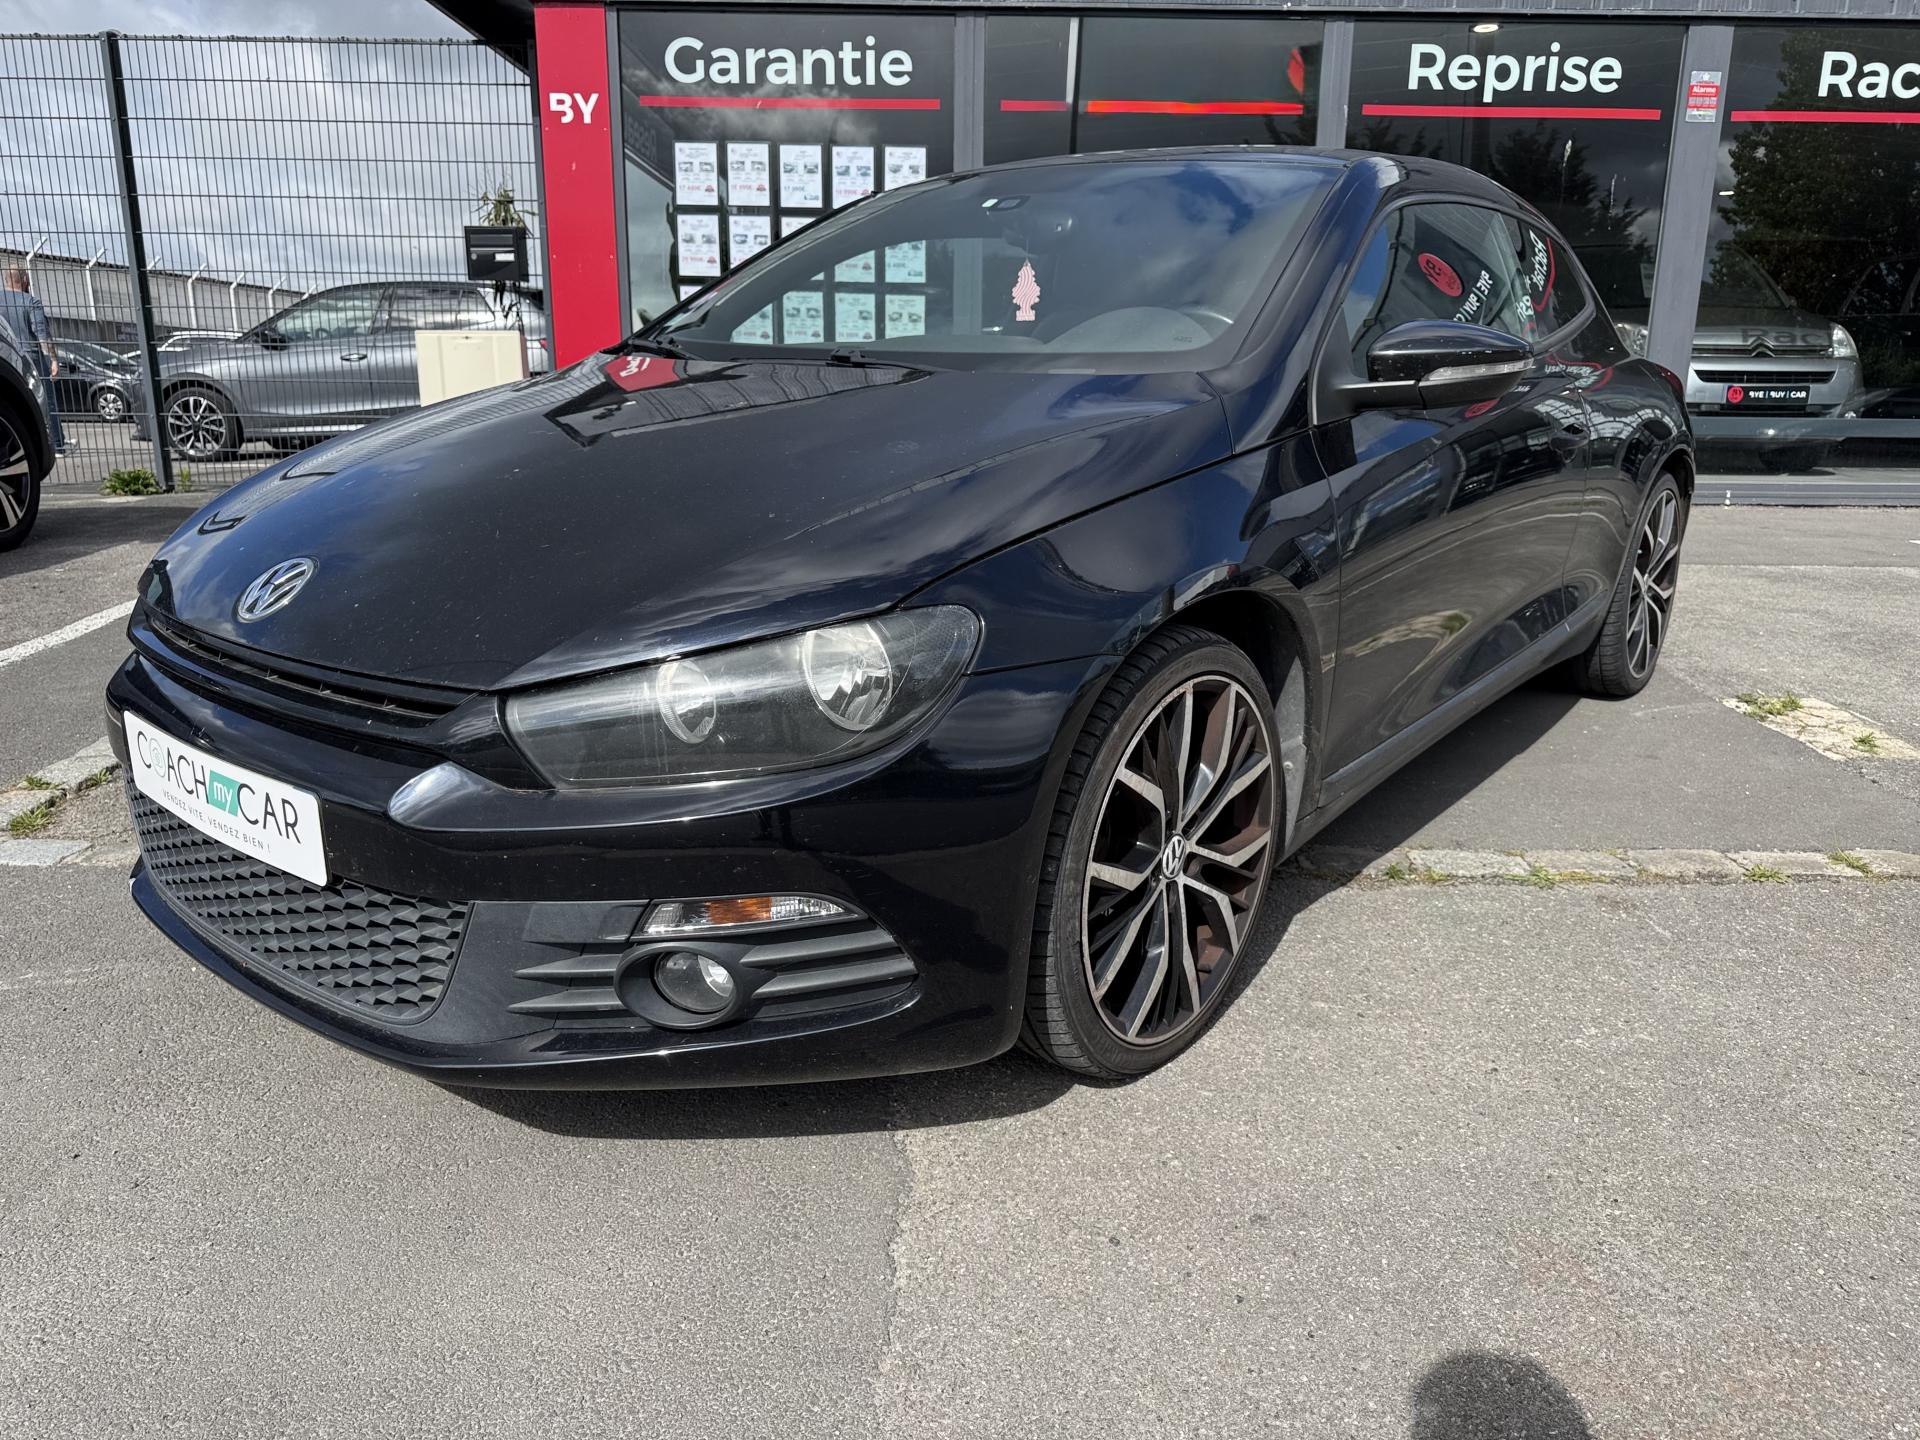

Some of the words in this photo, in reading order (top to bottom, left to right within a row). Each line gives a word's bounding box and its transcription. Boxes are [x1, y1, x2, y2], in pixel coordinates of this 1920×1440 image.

[664, 35, 913, 86] Garantie
[1408, 42, 1623, 103] Reprise
[1818, 51, 1920, 98] Rac
[549, 92, 600, 124] BY
[163, 789, 186, 811] VENDEZ
[208, 817, 240, 839] VENDEZ
[243, 834, 264, 849] BIEN
